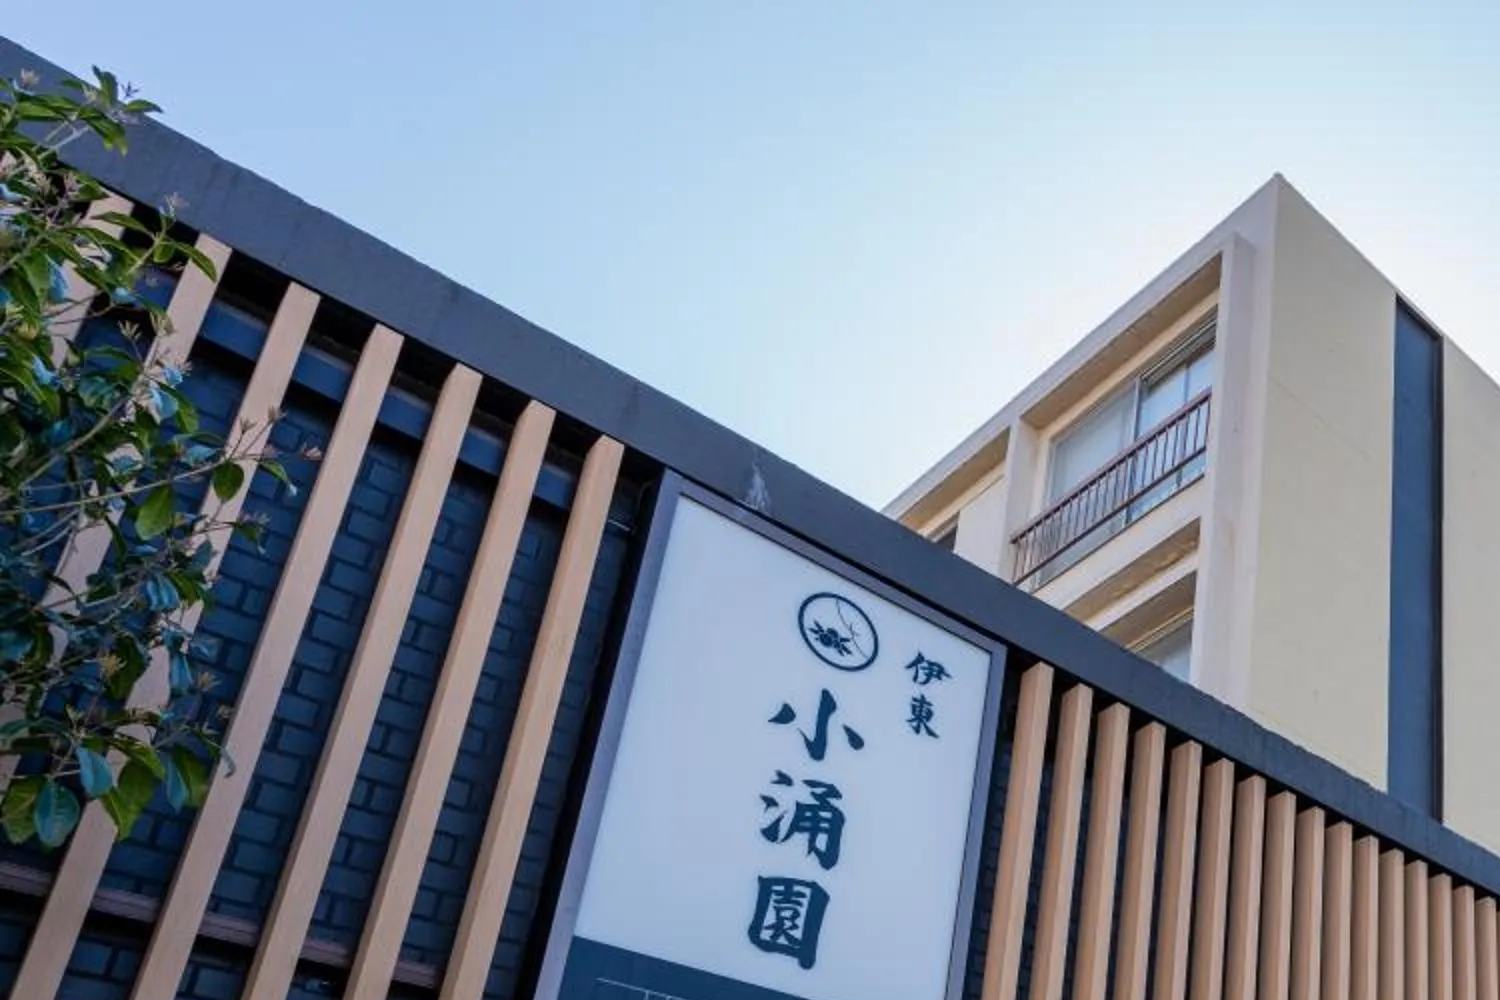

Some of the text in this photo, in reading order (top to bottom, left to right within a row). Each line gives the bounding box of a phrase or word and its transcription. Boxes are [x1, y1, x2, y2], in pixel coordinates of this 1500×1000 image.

[905, 651, 952, 739] 伊東
[747, 688, 865, 970] 小涌園
